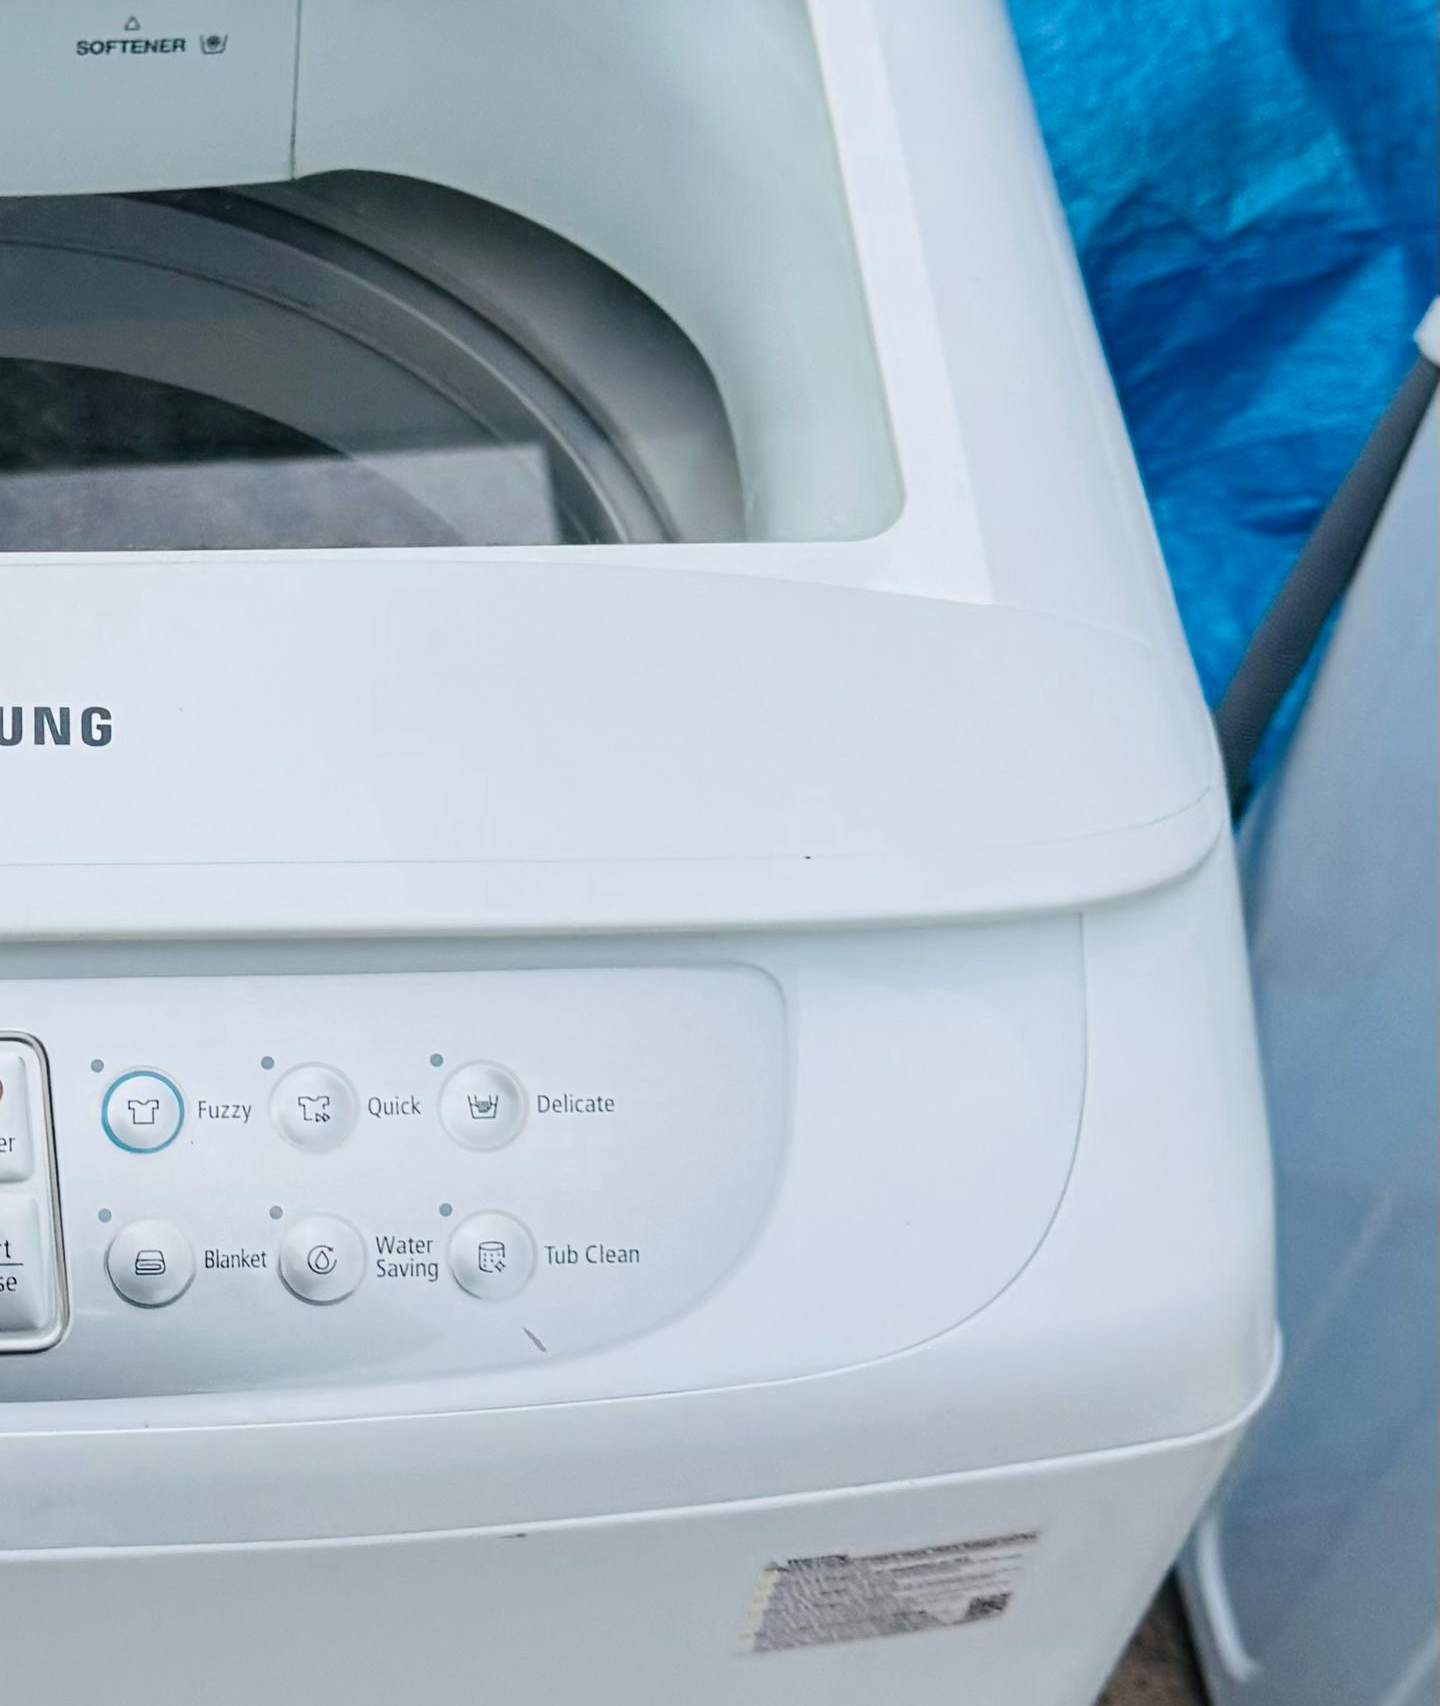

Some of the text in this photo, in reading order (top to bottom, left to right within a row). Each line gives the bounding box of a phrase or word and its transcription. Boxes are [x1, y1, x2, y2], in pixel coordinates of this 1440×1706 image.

[76, 37, 187, 56] SOFTENER
[198, 1100, 252, 1124] Fuzzy
[367, 1095, 422, 1119] Quick
[537, 1093, 615, 1114] Delicate
[375, 1235, 433, 1255] Water
[544, 1244, 640, 1265] Tub Clean
[204, 1248, 267, 1269] Blanket
[376, 1258, 439, 1283] Saving
